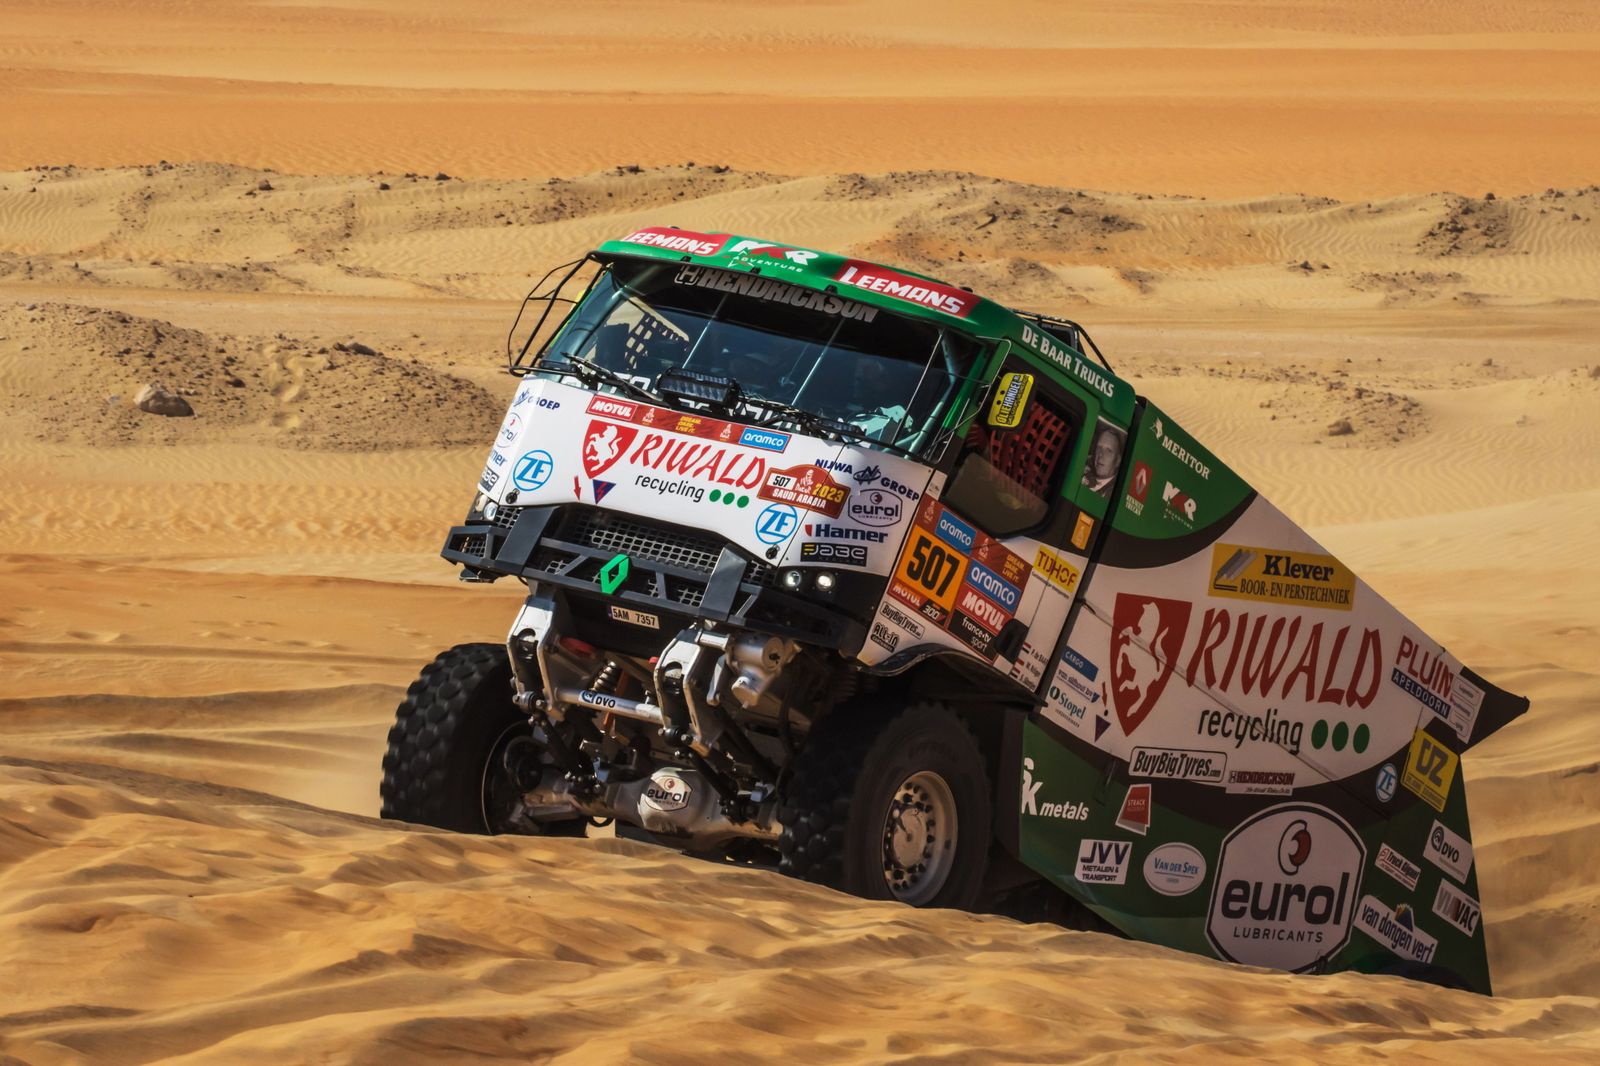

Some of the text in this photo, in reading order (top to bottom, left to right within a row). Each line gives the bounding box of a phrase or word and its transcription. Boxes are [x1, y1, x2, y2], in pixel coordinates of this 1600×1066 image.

[619, 232, 720, 255] LEEMANS
[697, 268, 879, 323] HENDRICKSON
[838, 266, 966, 316] LEEMANS
[1022, 325, 1114, 397] DE BAAR TRUCKS
[592, 402, 632, 417] MOTUL
[744, 432, 784, 447] aramco
[630, 433, 766, 490] RIWALD
[814, 459, 853, 475] NIJWA
[1162, 435, 1211, 480] MERITOR
[515, 455, 552, 487] ZF
[773, 475, 791, 487] 507
[635, 474, 705, 503] recycling
[772, 488, 827, 509] SAUDI ARABIA
[812, 482, 844, 503] 2023
[880, 477, 920, 501] GROEP
[758, 506, 797, 540] ZF
[851, 504, 899, 518] eurol
[815, 524, 888, 543] Hamer
[940, 519, 971, 546] aramco
[906, 535, 960, 598] 507
[1037, 551, 1077, 586] TIJHOF
[1262, 554, 1334, 582] Klever
[893, 583, 921, 607] MOTUL
[971, 567, 1015, 605] aramco
[1239, 578, 1350, 605] BOOR- EN PERSTECHNIEK
[613, 608, 656, 626] 5AM 7357
[962, 591, 1005, 631] MOTUL
[971, 636, 987, 652] sport
[1186, 607, 1382, 709] RIWALD
[595, 696, 616, 709] DVO
[1058, 692, 1086, 719] Stopel
[1393, 671, 1449, 718] APELDOORN
[1198, 708, 1304, 755] recycling
[647, 789, 688, 803] eurol
[1039, 801, 1089, 821] metals
[1081, 842, 1130, 865] JVV
[1441, 842, 1459, 863] DVO
[1082, 865, 1114, 873] METALEN
[1082, 874, 1118, 882] TRANSPORT
[1221, 872, 1350, 925] eurol
[1233, 926, 1324, 943] LUBRICANTS
[1361, 904, 1434, 964] van dongen verf
